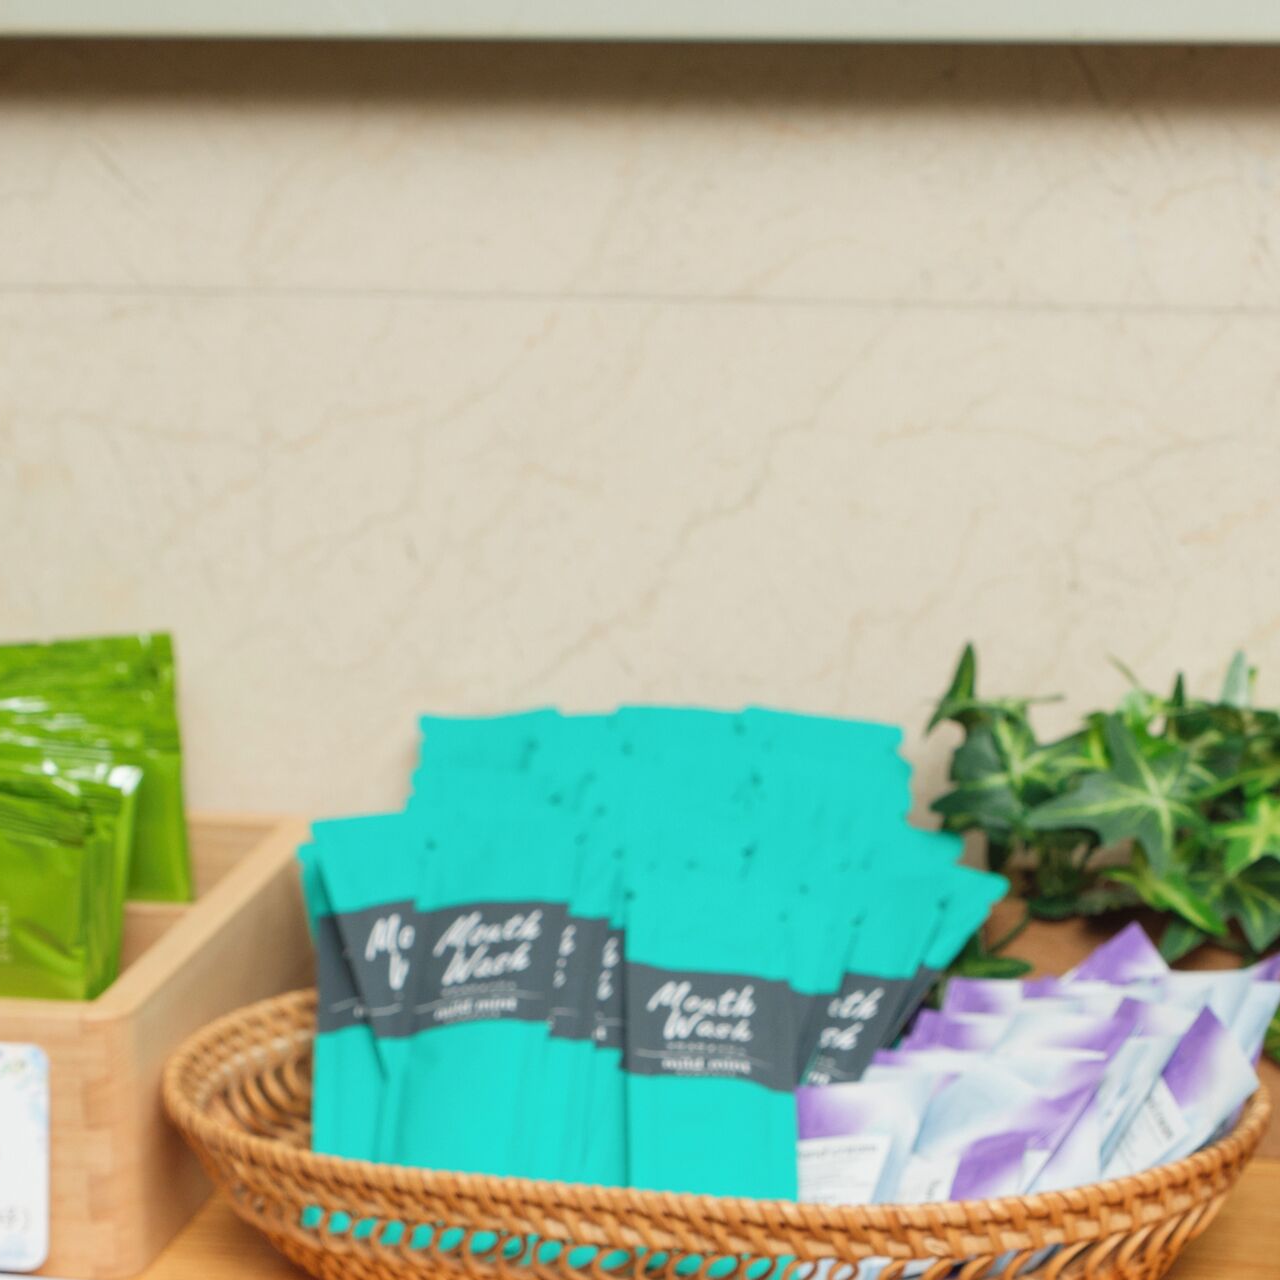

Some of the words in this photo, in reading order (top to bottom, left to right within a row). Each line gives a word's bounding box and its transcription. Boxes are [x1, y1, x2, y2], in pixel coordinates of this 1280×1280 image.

[432, 909, 543, 957] Mouth
[442, 942, 532, 986] Wash
[646, 980, 757, 1018] Mouth
[662, 1010, 753, 1042] Wash
